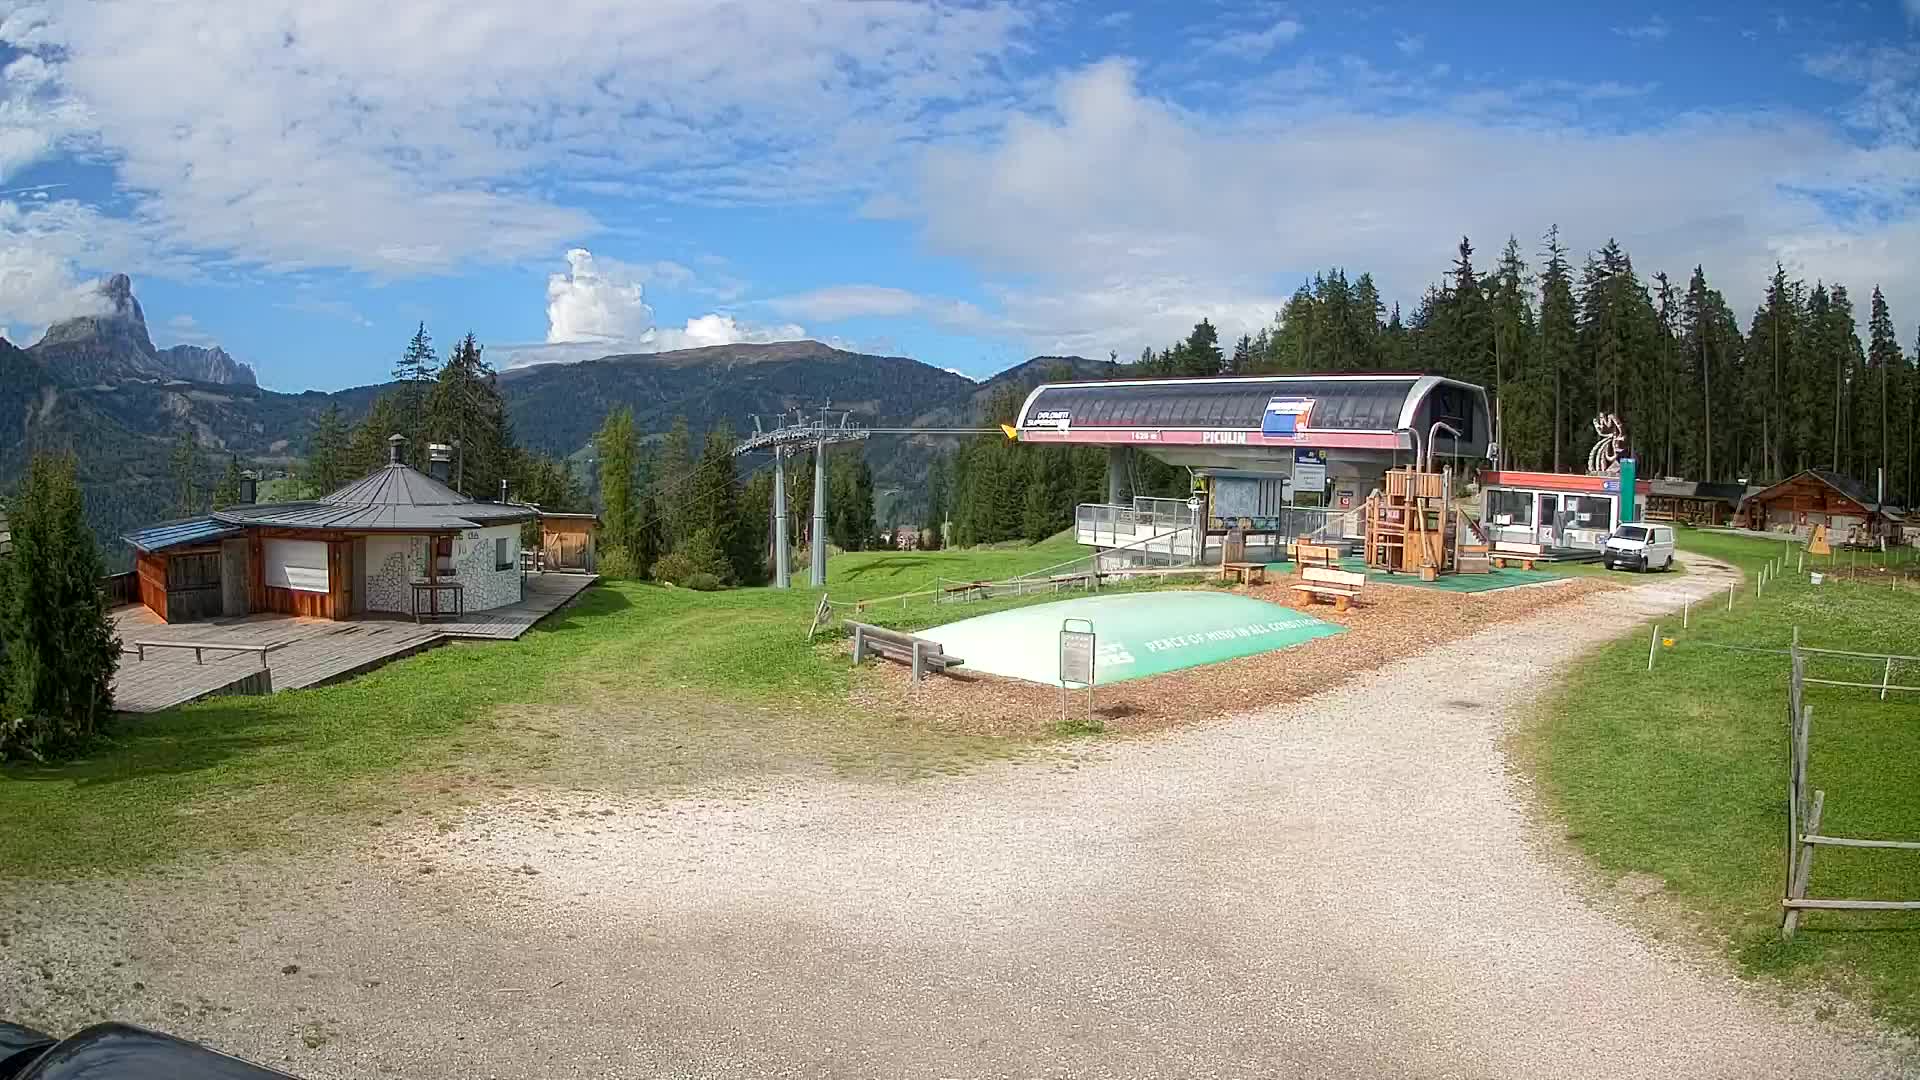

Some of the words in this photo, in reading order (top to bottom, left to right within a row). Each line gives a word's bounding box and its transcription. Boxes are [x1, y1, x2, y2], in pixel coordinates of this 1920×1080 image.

[1203, 431, 1246, 445] PICULIN
[1145, 637, 1188, 652] PEACE
[1248, 623, 1271, 635] ALL
